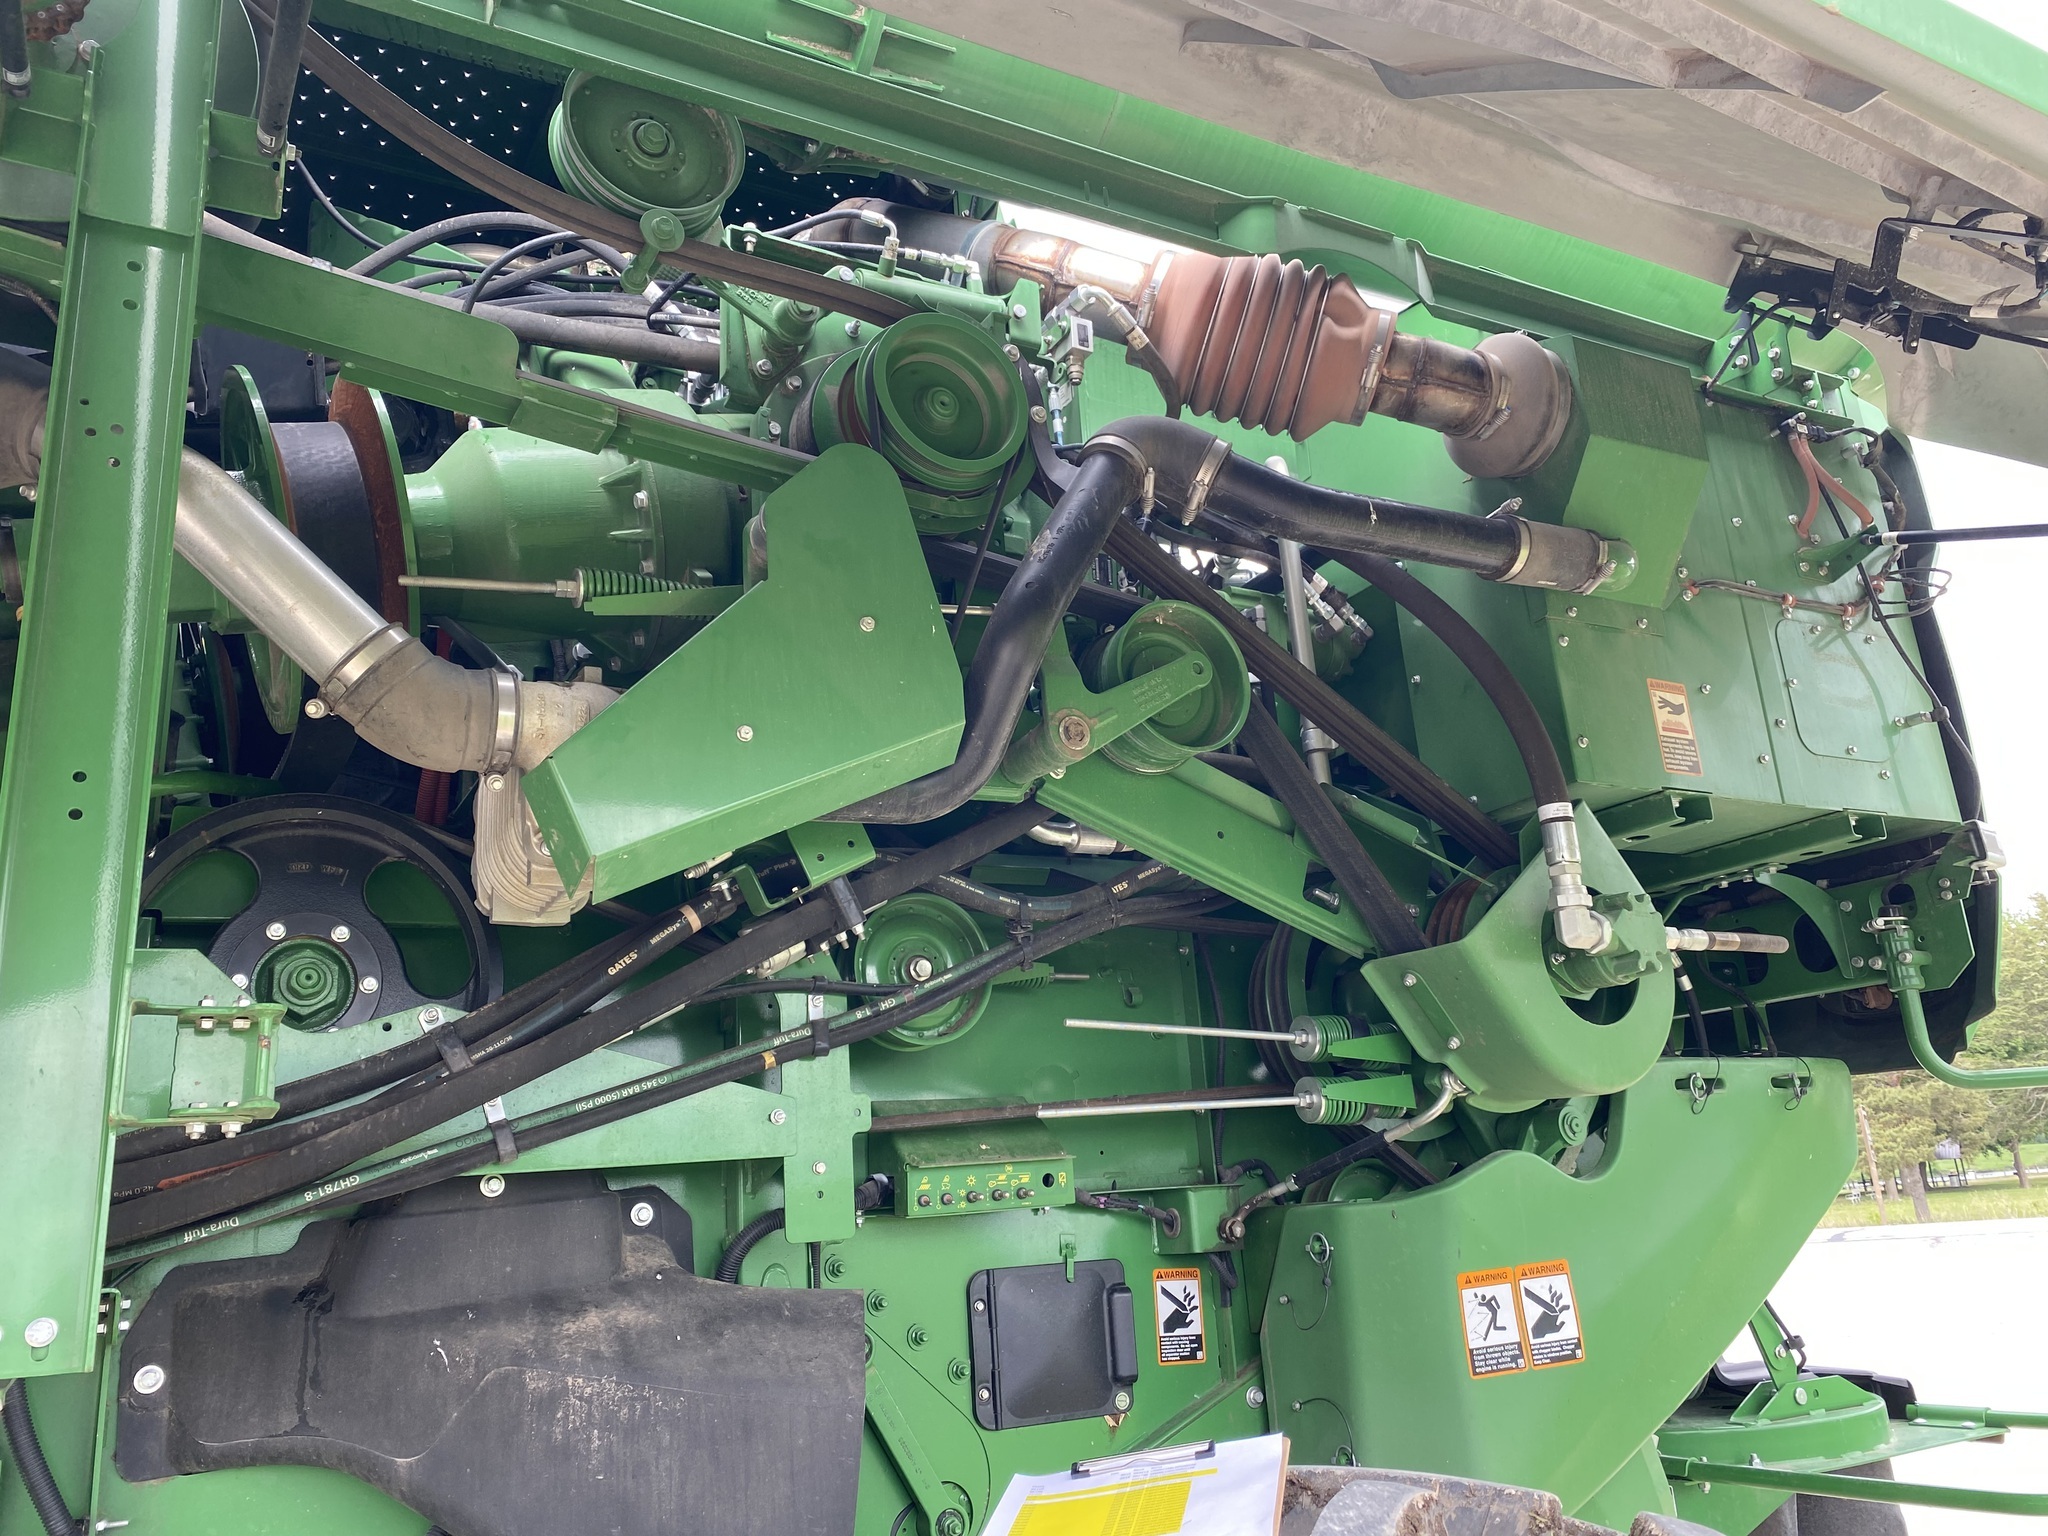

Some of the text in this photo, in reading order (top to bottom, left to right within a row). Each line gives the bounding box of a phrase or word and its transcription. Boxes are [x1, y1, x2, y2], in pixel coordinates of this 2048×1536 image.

[606, 950, 640, 977] GATES
[771, 1026, 812, 1046] Dura-Tuff
[574, 1078, 659, 1112] 345 BAR (5000 PSI)
[113, 1184, 154, 1199] 42.0 MPa
[303, 1173, 360, 1202] GH781-8
[182, 1214, 240, 1244] Dura-Tuff
[1164, 1270, 1198, 1279] WARNING
[1527, 1264, 1564, 1275] WARNING
[1473, 1272, 1508, 1283] WARNING
[1502, 1349, 1520, 1357] objects.
[1504, 1343, 1518, 1351] injury
[1497, 1362, 1517, 1370] running.
